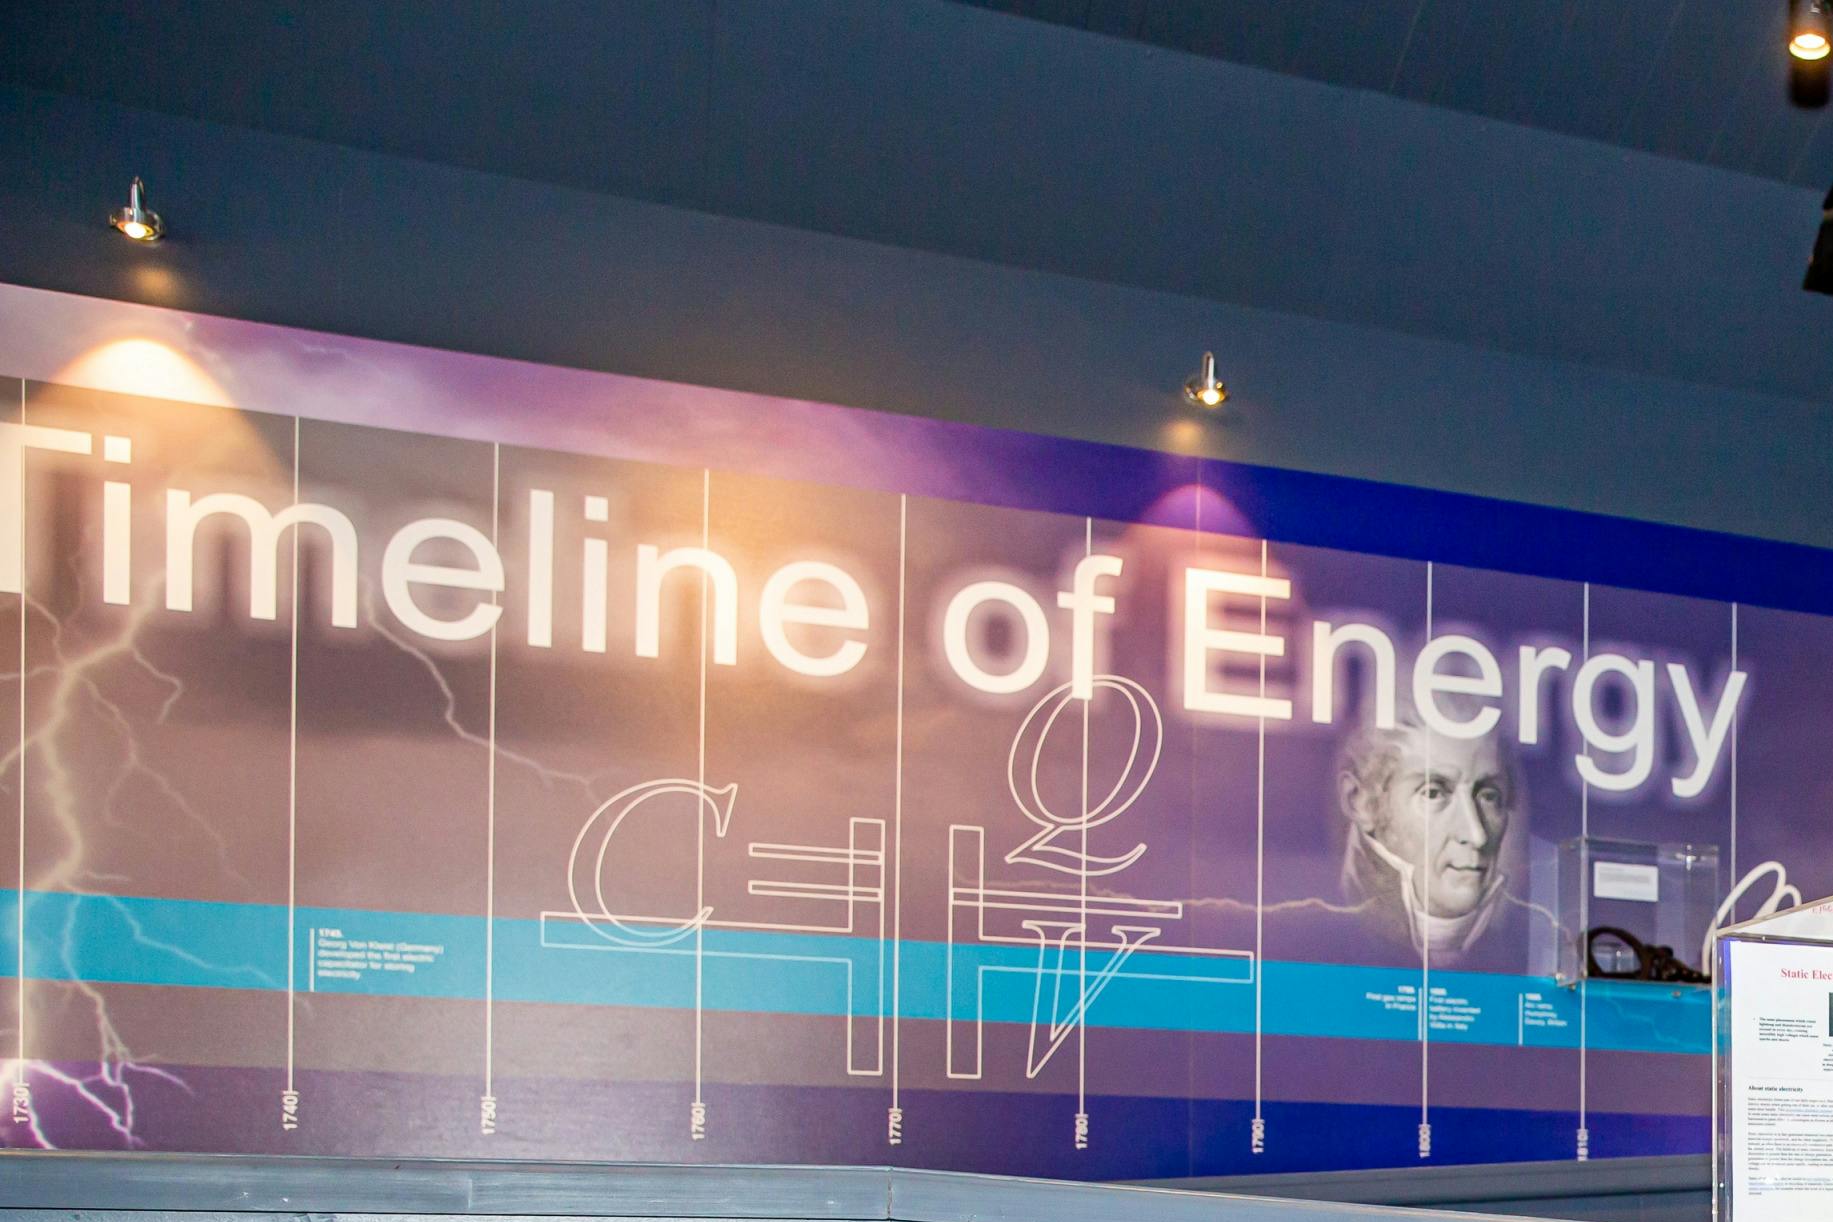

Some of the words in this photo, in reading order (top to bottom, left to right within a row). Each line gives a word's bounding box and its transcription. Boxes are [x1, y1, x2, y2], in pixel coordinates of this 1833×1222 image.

[0, 421, 869, 677] Timeline
[943, 555, 1123, 700] of
[1184, 567, 1747, 798] Energy
[1780, 968, 1809, 980] Static
[14, 1087, 30, 1124] 1730
[283, 1095, 298, 1131] 1740
[481, 1099, 496, 1134] 1750
[692, 1107, 705, 1139] 1760
[890, 1113, 902, 1145] 1770
[1076, 1119, 1088, 1150] 1780
[1252, 1123, 1264, 1154] 1790
[1419, 1128, 1431, 1158] 1800
[1577, 1132, 1588, 1161] 1810
